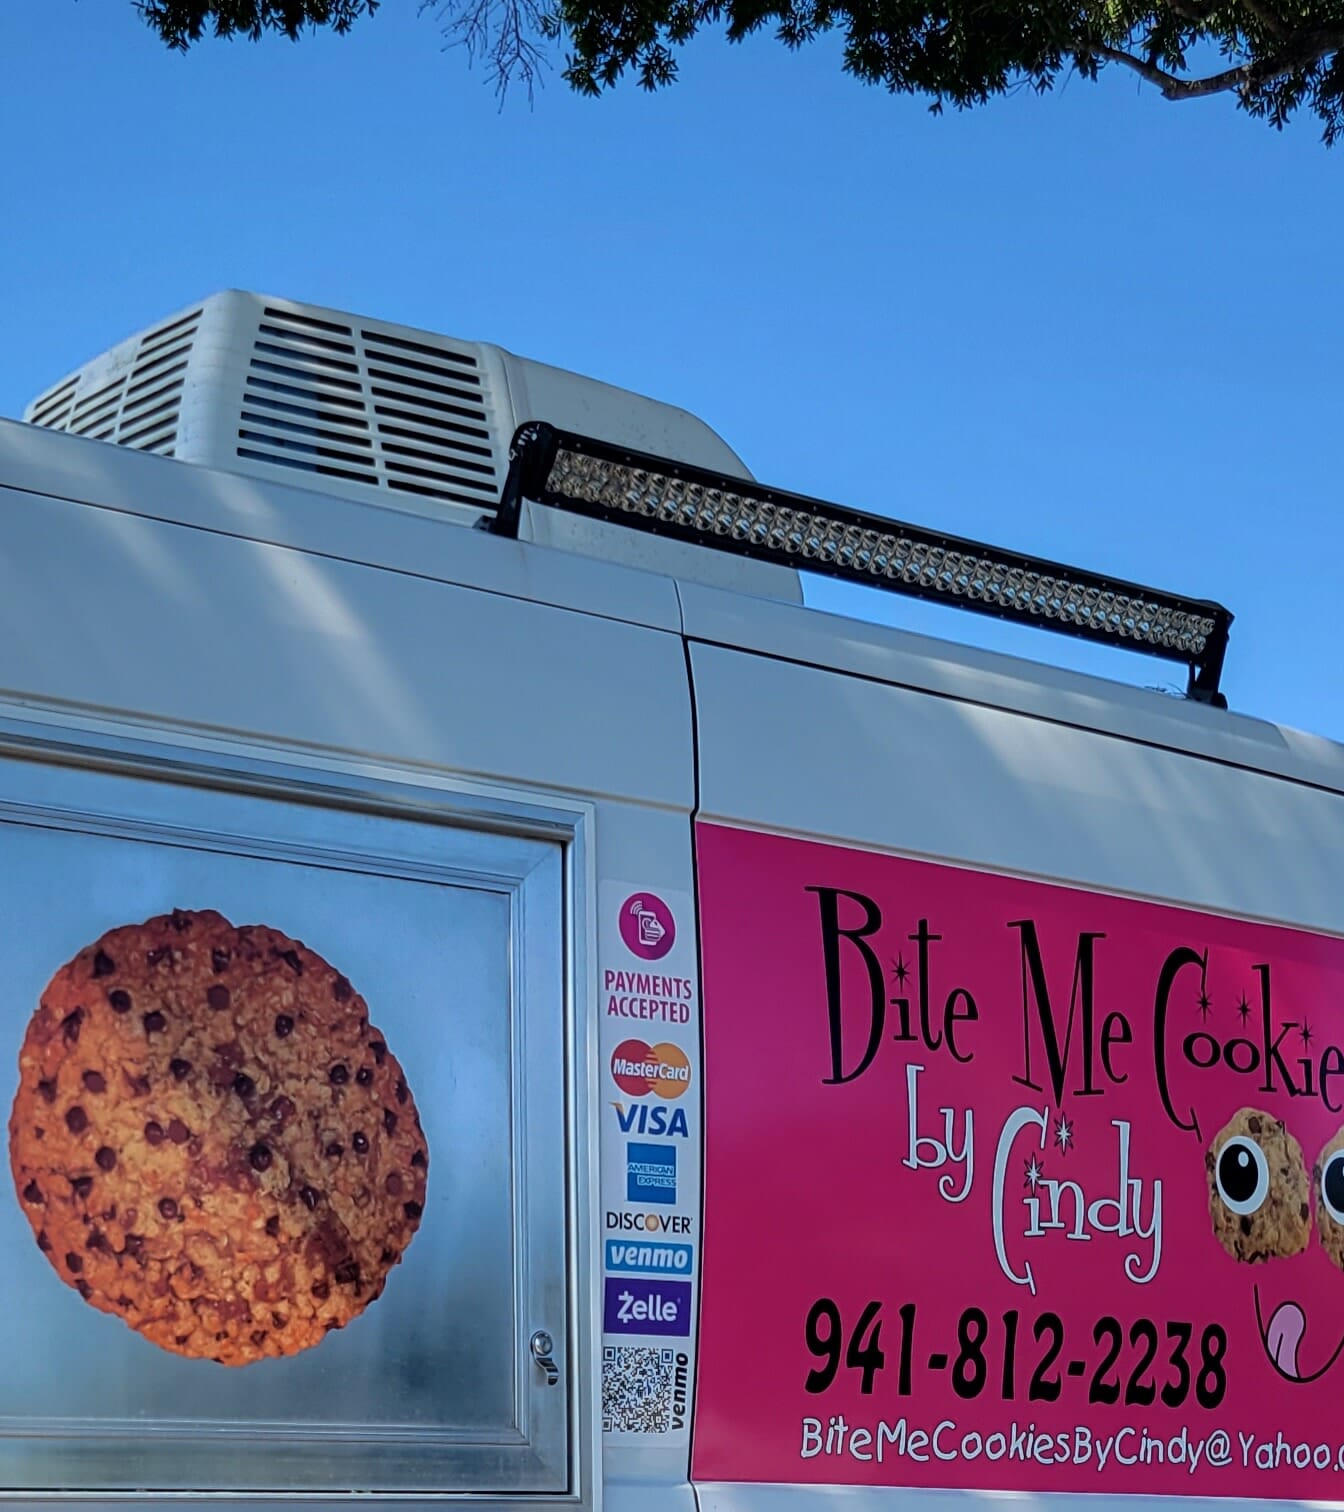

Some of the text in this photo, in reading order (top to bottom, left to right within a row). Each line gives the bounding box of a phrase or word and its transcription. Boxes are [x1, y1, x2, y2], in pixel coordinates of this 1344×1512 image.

[605, 969, 692, 1000] PAYMENTS
[806, 886, 978, 1085] Bite
[1007, 919, 1134, 1111] Me
[607, 995, 690, 1024] ACCEPTED
[613, 1058, 689, 1082] MasterCard
[609, 1101, 689, 1138] VISA
[627, 1163, 675, 1175] AMERICAN
[637, 1175, 677, 1187] EXPRESS
[902, 1064, 1164, 1295] by Cindy
[606, 1211, 692, 1234] DISCOVER
[610, 1243, 688, 1270] venmo
[617, 1290, 678, 1325] Zelle
[804, 1297, 1228, 1409] 941-812-2238
[671, 1352, 690, 1431] venmo
